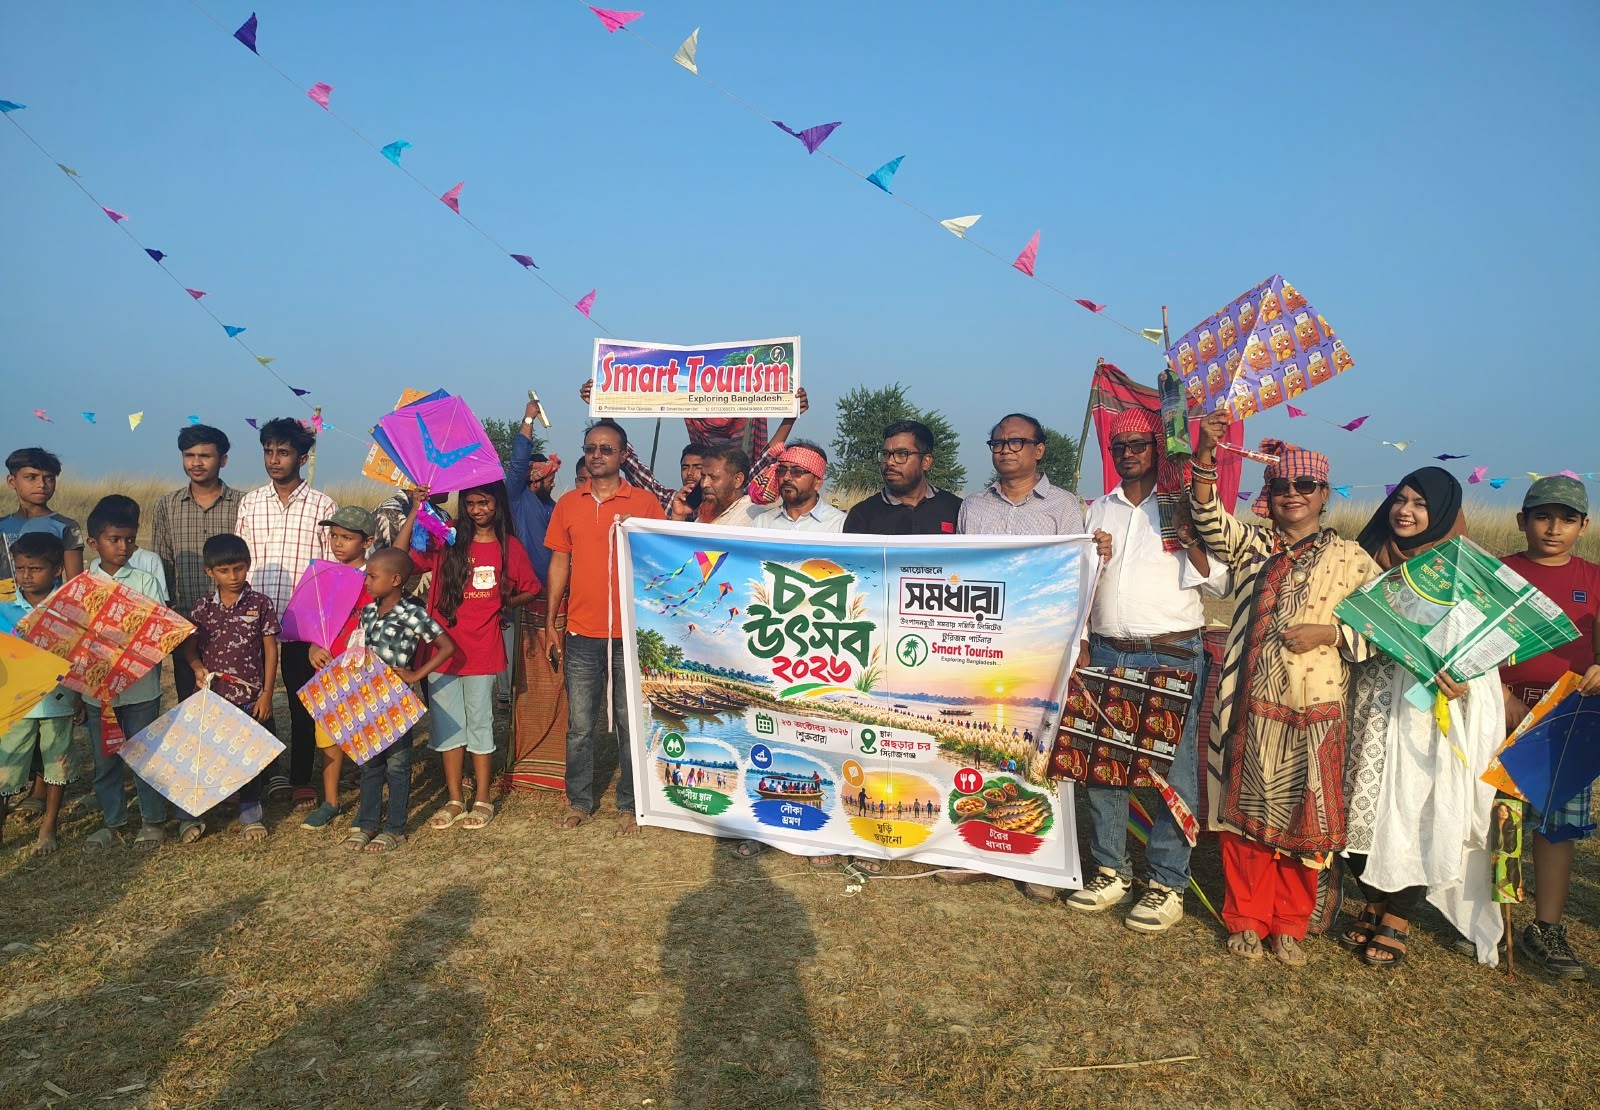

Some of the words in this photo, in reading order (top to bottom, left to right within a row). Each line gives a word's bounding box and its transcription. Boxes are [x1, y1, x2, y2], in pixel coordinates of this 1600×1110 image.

[601, 351, 680, 393] Smart
[686, 353, 790, 394] Tourism
[688, 394, 729, 404] Exploring
[900, 566, 943, 575] আয়োজনে
[762, 560, 856, 621] চর
[904, 582, 1000, 622] সমধারা
[741, 604, 877, 670] উৎসব
[968, 634, 993, 645] পার্টনার
[931, 641, 962, 656] Smart
[964, 645, 1004, 660] Tourism
[941, 656, 965, 665] Exploring
[771, 655, 852, 684] ২০২৬
[780, 718, 792, 727] ২৩
[793, 720, 827, 733] অক্টোবর
[828, 726, 849, 736] ২০২৬
[917, 743, 931, 751] চর
[780, 803, 803, 815] নৌকা
[781, 815, 801, 827] ভ্রমণ
[989, 828, 1009, 841] চরের
[985, 839, 1012, 852] খাবার
